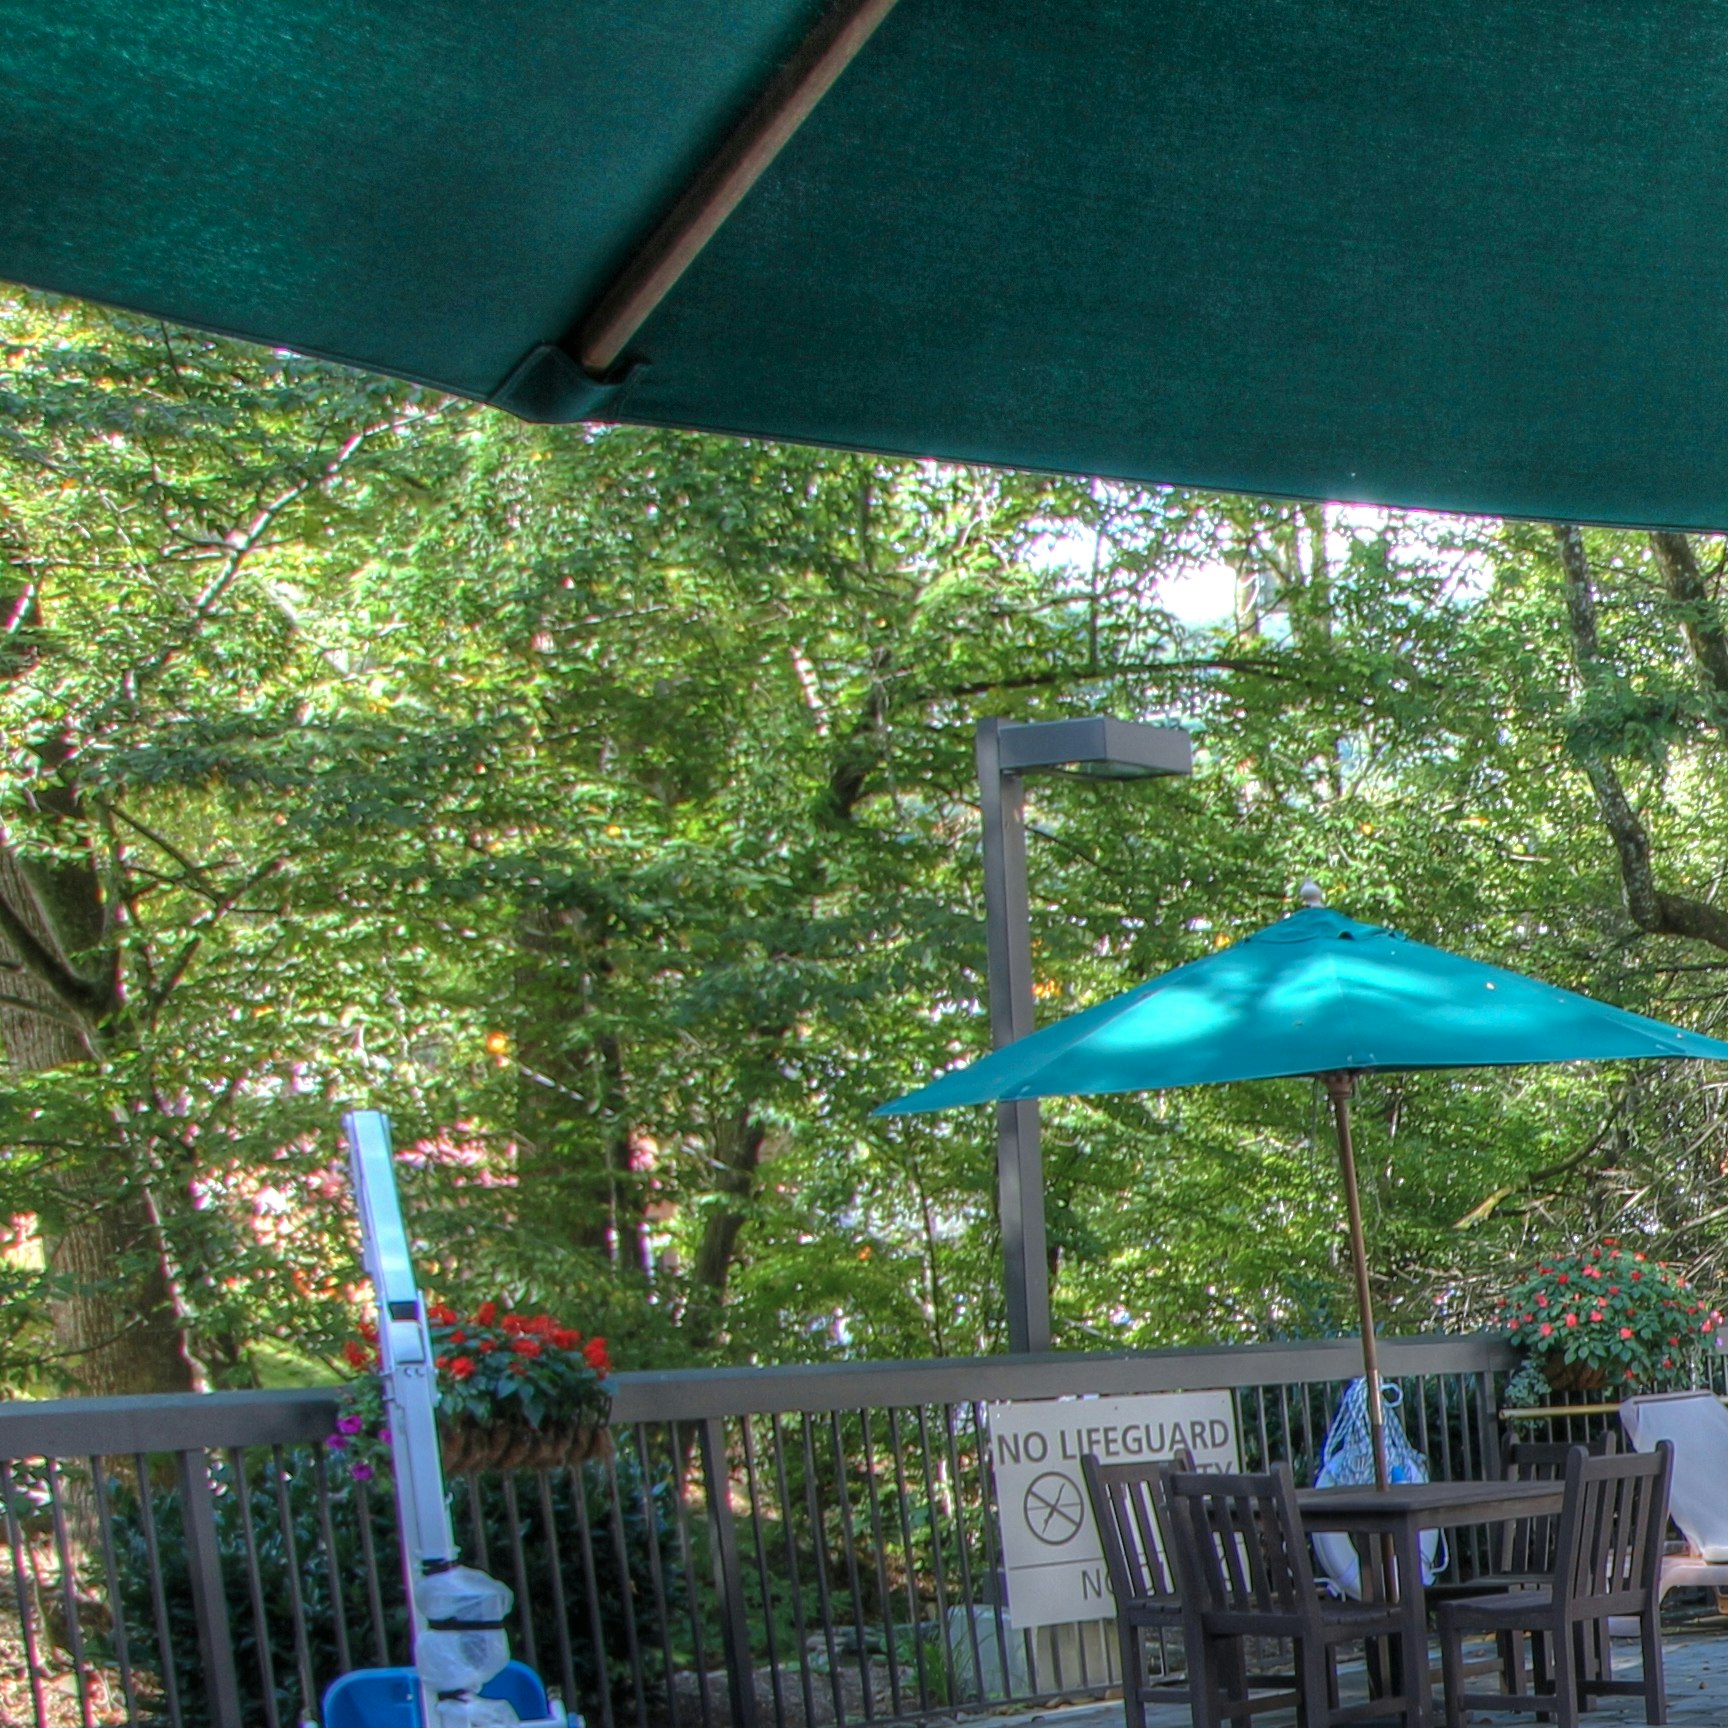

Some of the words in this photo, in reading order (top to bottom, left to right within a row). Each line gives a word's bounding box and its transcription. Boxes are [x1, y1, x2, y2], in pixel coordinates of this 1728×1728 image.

[997, 1431, 1049, 1465] NO
[1060, 1419, 1230, 1461] LIFEGUARD
[1081, 1569, 1115, 1601] N
